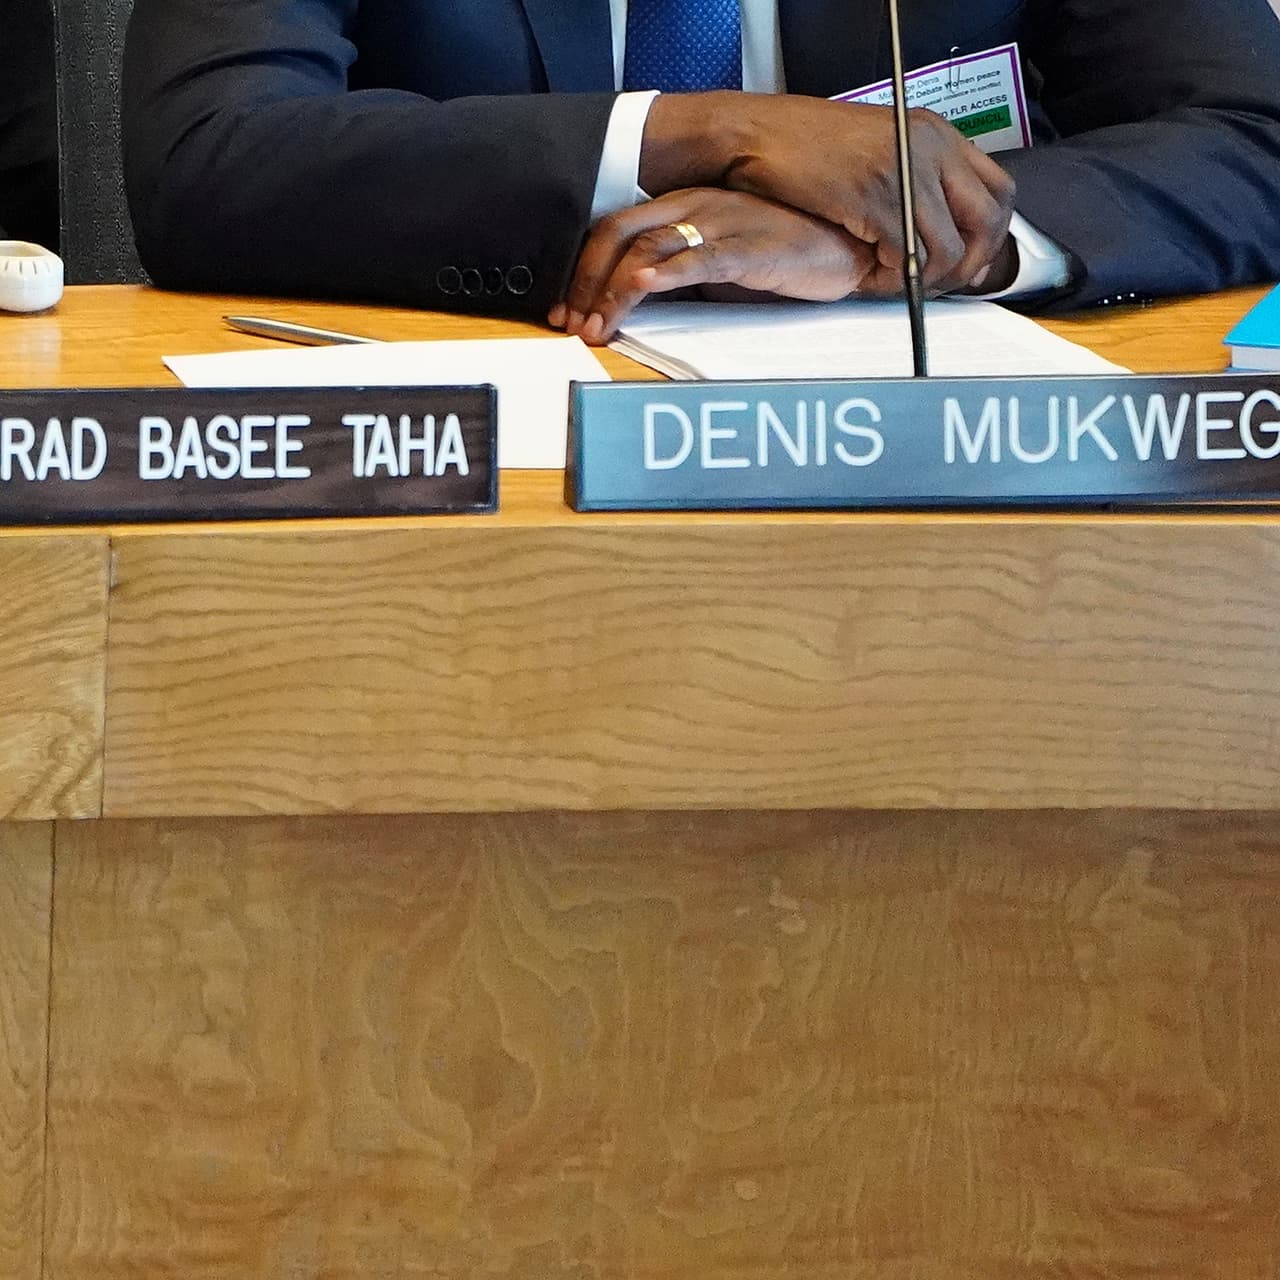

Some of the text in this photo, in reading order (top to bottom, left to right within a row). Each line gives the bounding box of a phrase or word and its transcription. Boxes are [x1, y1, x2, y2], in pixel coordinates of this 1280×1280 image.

[916, 86, 943, 98] Debate
[945, 77, 975, 89] Women
[977, 70, 1001, 81] peace
[950, 105, 968, 116] FLR
[970, 94, 1008, 108] ACCESS
[139, 414, 311, 480] BASEE
[341, 413, 470, 477] TAHA
[643, 389, 1280, 470] DENIS MUKWEG
